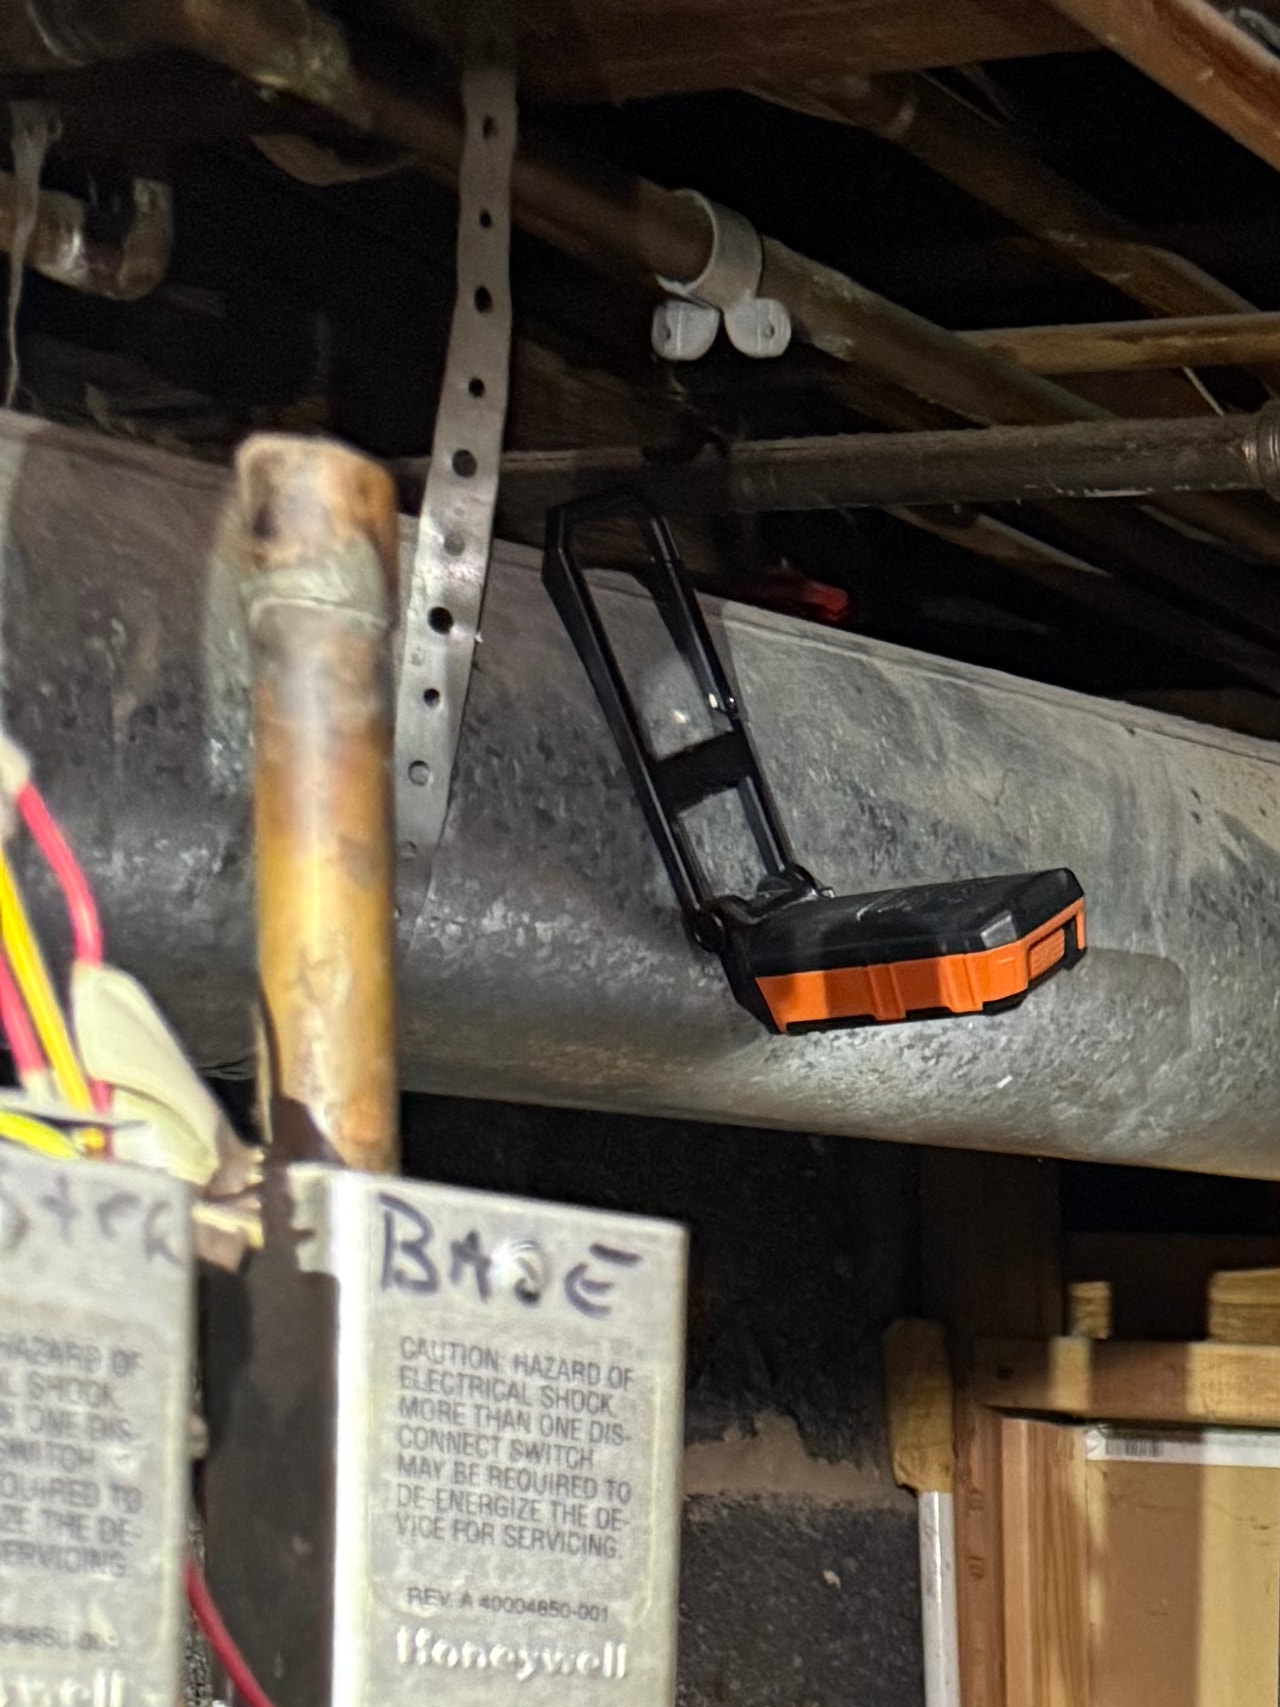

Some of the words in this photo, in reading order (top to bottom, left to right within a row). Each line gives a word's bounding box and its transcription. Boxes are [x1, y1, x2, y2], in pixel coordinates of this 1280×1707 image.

[400, 1365, 532, 1407] ELECTRICAL
[513, 1353, 601, 1387] HAZARD
[608, 1366, 635, 1390] OF
[399, 1395, 465, 1426] MORE
[474, 1404, 532, 1434] THAN
[539, 1414, 583, 1441] ONE
[399, 1424, 501, 1458] CONNECT
[509, 1438, 594, 1470] SWITCH
[398, 1454, 445, 1480] MAY
[454, 1461, 481, 1485] BE
[488, 1465, 598, 1500] REQUIRED
[605, 1479, 632, 1505] TO
[396, 1513, 445, 1540] VICE
[453, 1519, 495, 1544] FOR
[397, 1483, 543, 1523] DE-ENERGIZE
[550, 1500, 589, 1529] THE
[397, 1625, 628, 1680] Honeywell
